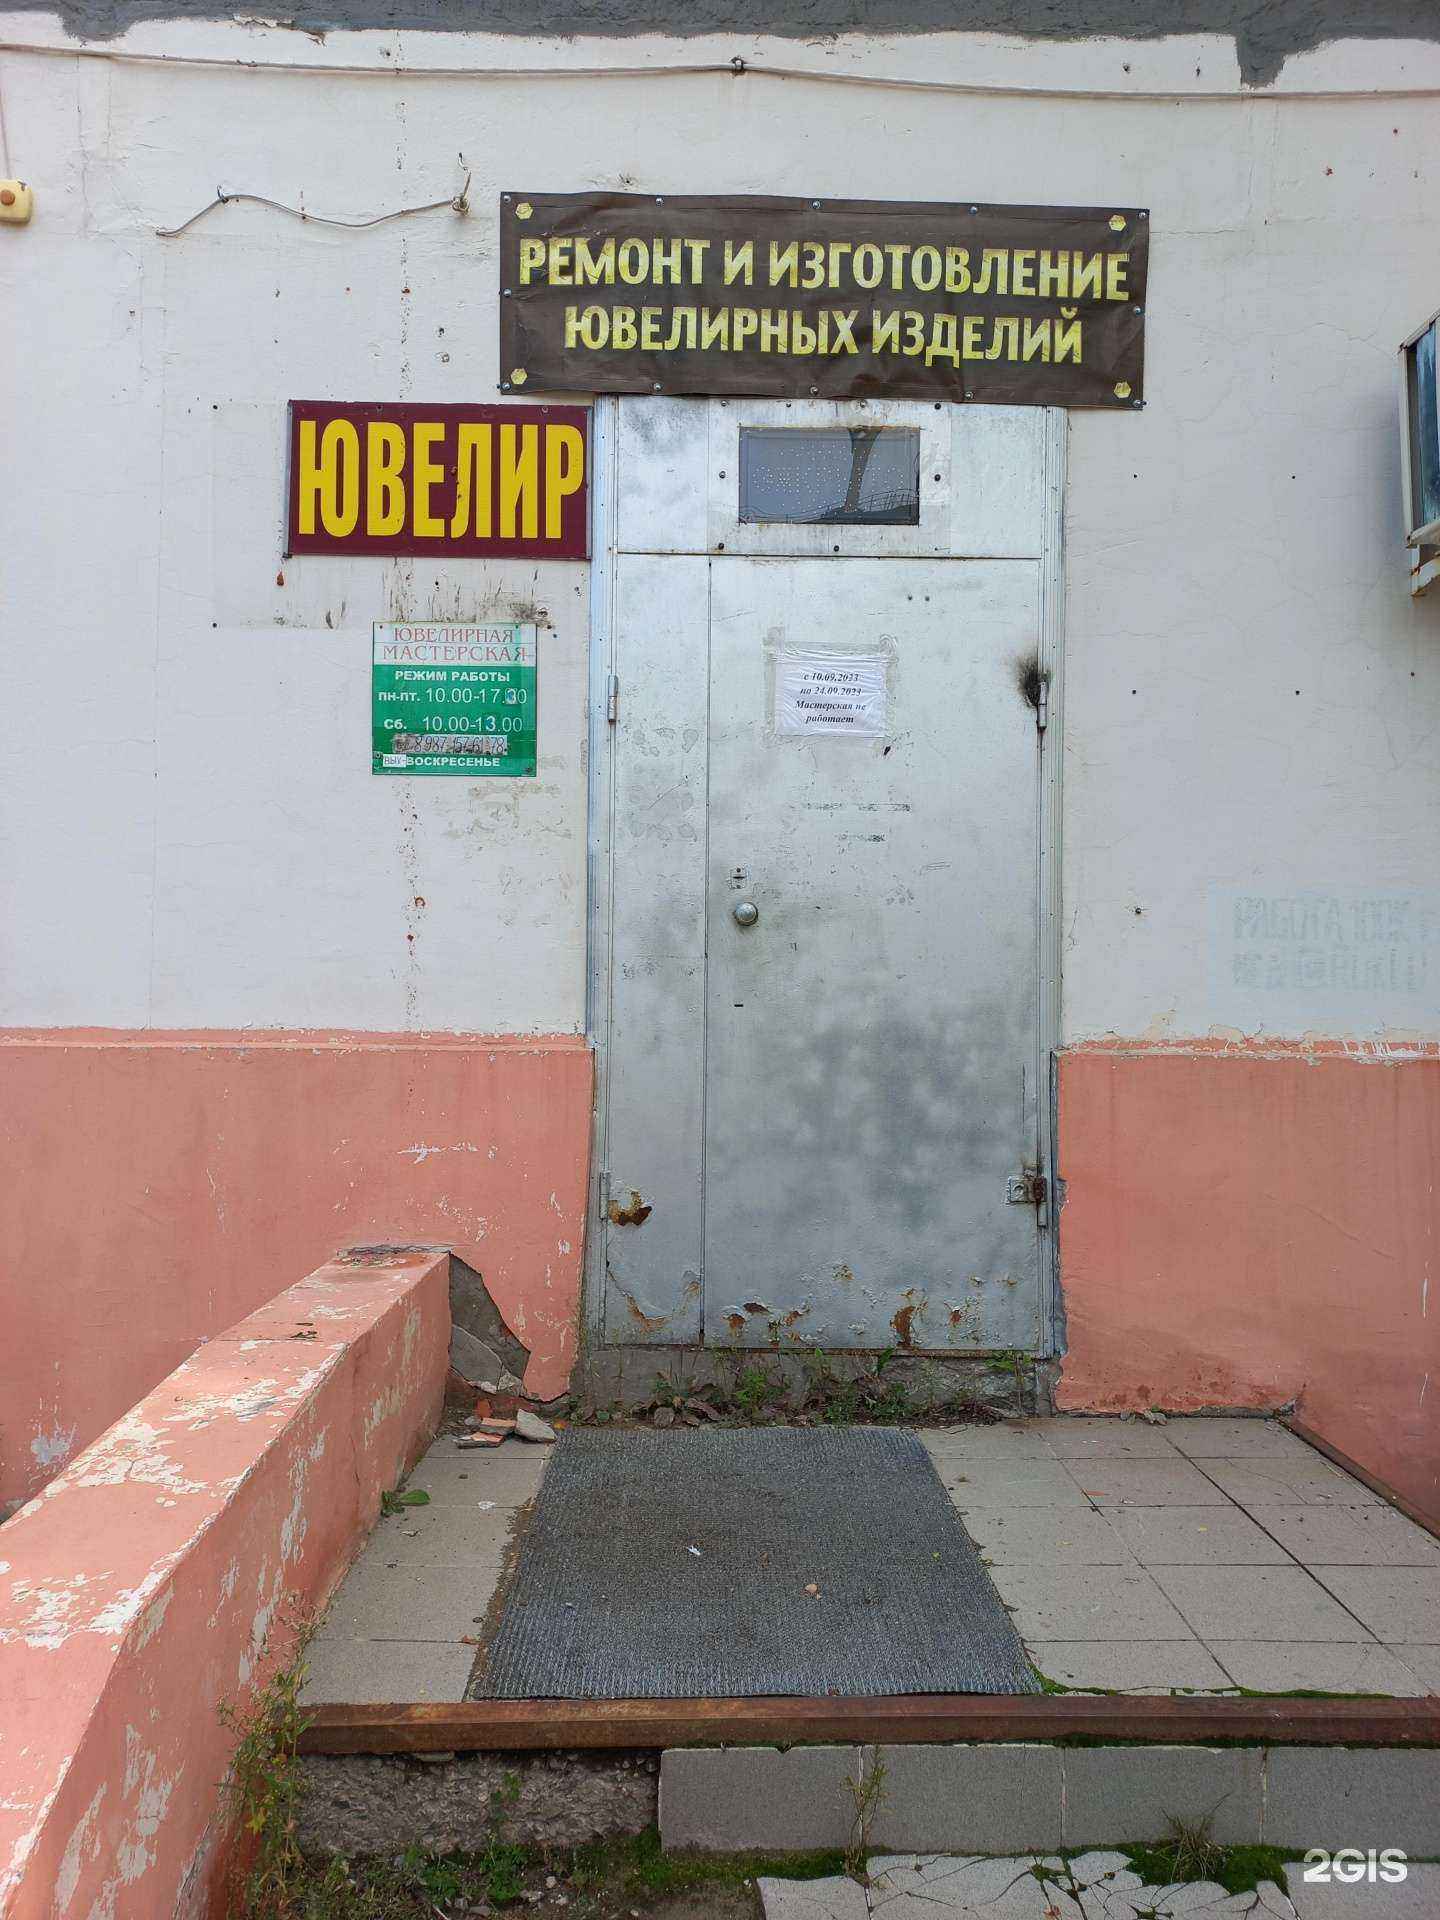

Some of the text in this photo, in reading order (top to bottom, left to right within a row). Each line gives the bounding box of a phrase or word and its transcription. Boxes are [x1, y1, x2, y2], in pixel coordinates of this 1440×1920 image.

[519, 237, 1131, 301] РЕМОНТ И ИЗГОТОВЛЕНИЕ
[564, 304, 1083, 369] ЮВЕЛИРНЫХ ИЗДЕЛИЙ
[298, 418, 585, 539] ЮВЕЛИР
[394, 627, 513, 643] ЮВЕЛИРНАЯ
[383, 645, 526, 661] МАСТЕРСКАЯ
[395, 670, 510, 682] РЕЖИМ РАБОТЫ
[803, 673, 810, 681] с
[800, 687, 812, 696] по
[795, 700, 867, 711] Мастерская не
[383, 715, 523, 732] Сб. 10.00-13.00
[805, 714, 854, 724] работает
[406, 756, 501, 767] ВОСКРЕСЕНЬЕ
